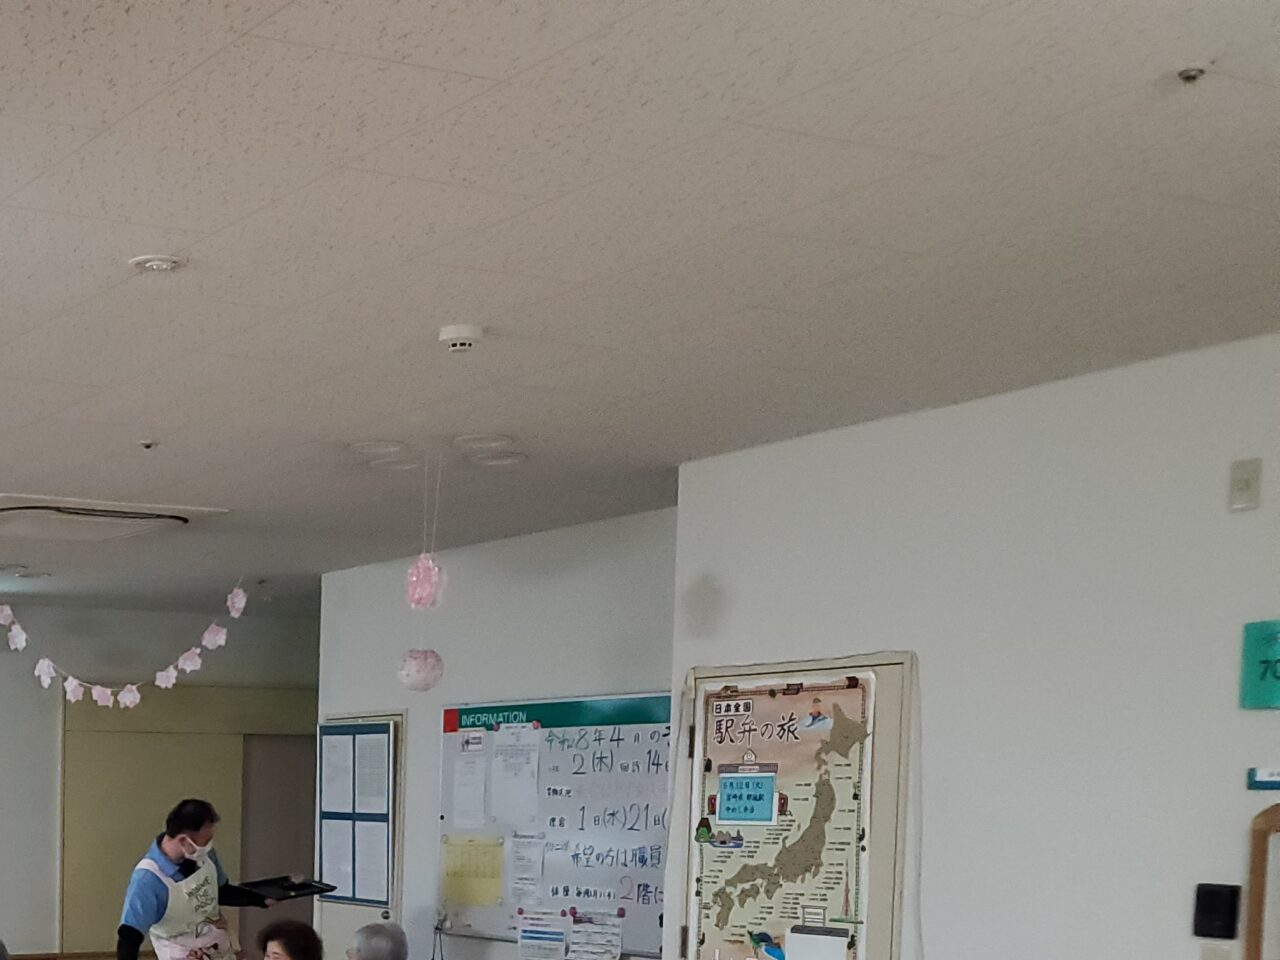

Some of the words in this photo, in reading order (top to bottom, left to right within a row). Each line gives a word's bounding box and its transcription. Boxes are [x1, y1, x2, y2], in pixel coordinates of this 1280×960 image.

[715, 701, 752, 714] 日本全国
[461, 711, 527, 726] INFORMATION
[713, 712, 800, 746] 駅弁の旅
